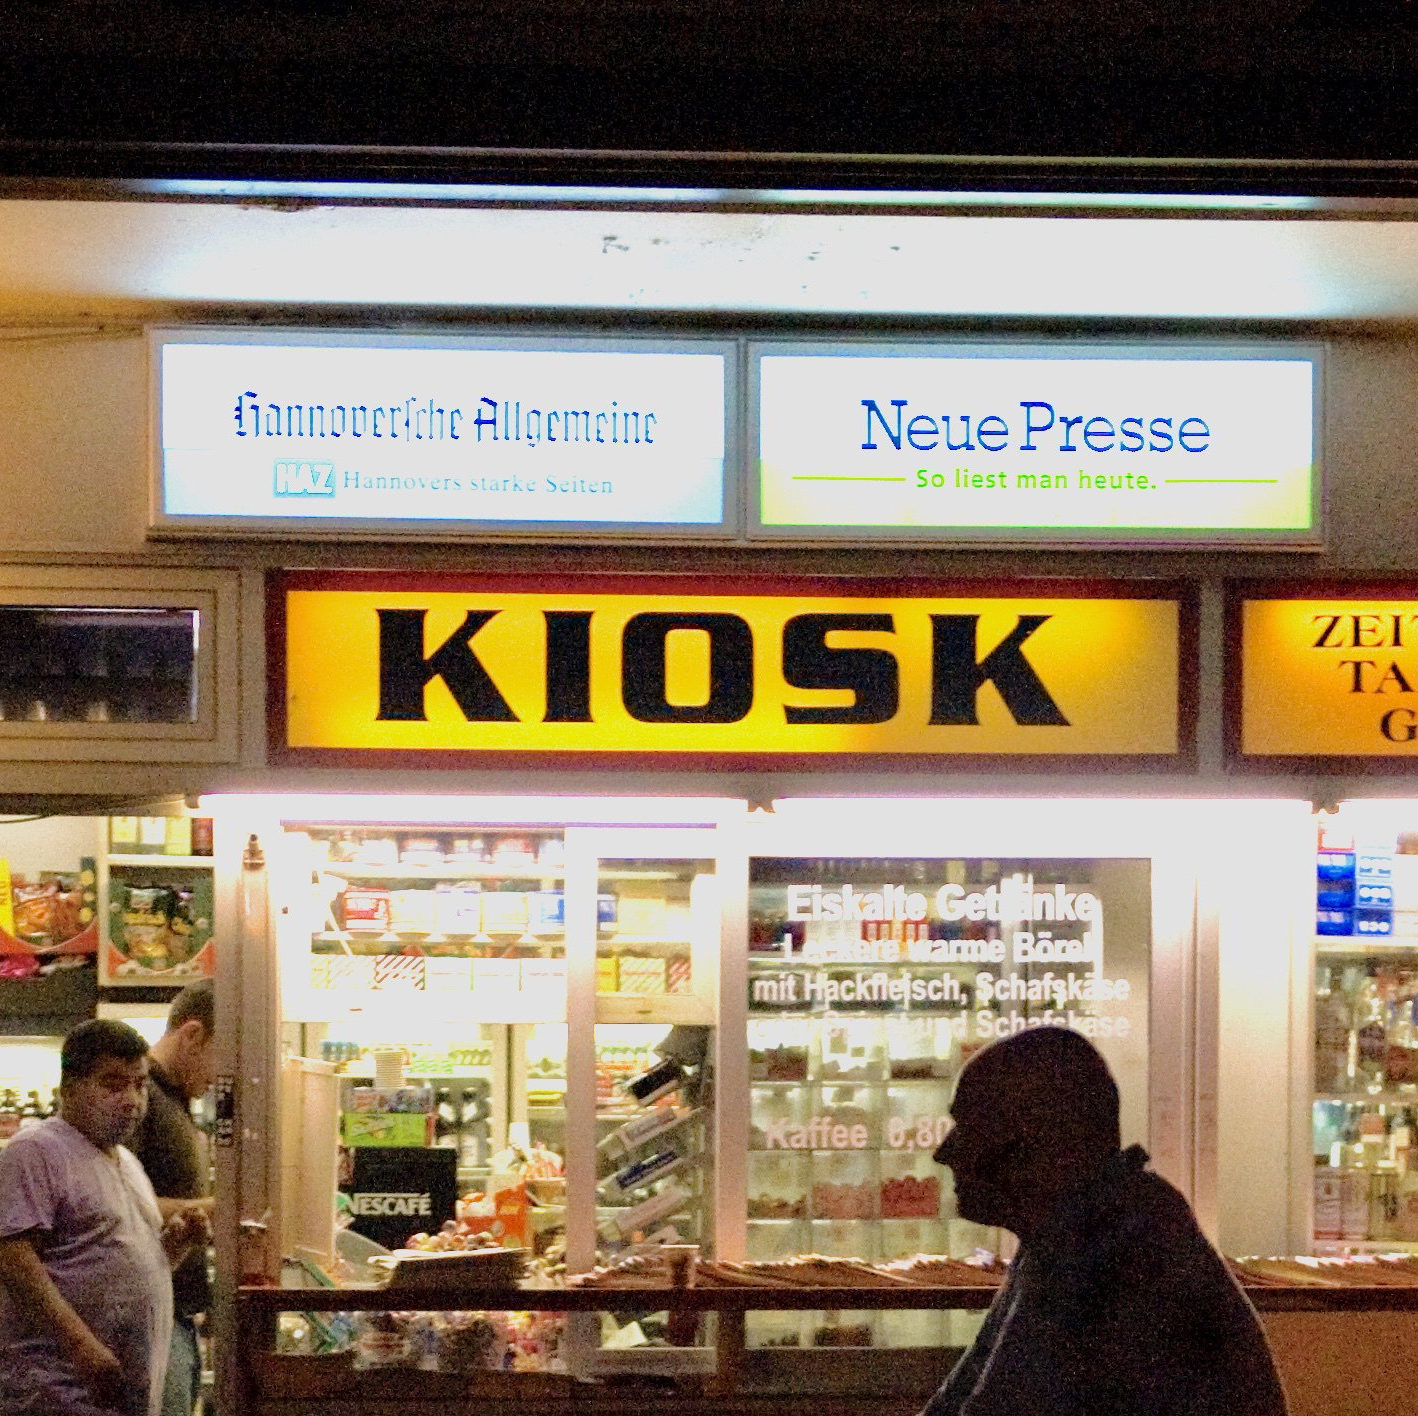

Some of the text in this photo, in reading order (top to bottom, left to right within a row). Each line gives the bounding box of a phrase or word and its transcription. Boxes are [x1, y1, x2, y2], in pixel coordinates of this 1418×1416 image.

[474, 397, 658, 447] Allgemeine
[861, 399, 1211, 453] Neue Presse
[275, 462, 614, 495] HAZ Hannovers starke Seiten
[915, 468, 1158, 491] So liest man heute.
[373, 607, 1072, 727] KIOSK
[787, 884, 928, 921] Eiskalte
[783, 932, 900, 962] Leckere
[908, 939, 1006, 963] warme
[754, 971, 1131, 1005] mit Hackfleisch, Schafskäse
[766, 1115, 868, 1149] Kaffee
[347, 1192, 432, 1217] NESCAFÉ
